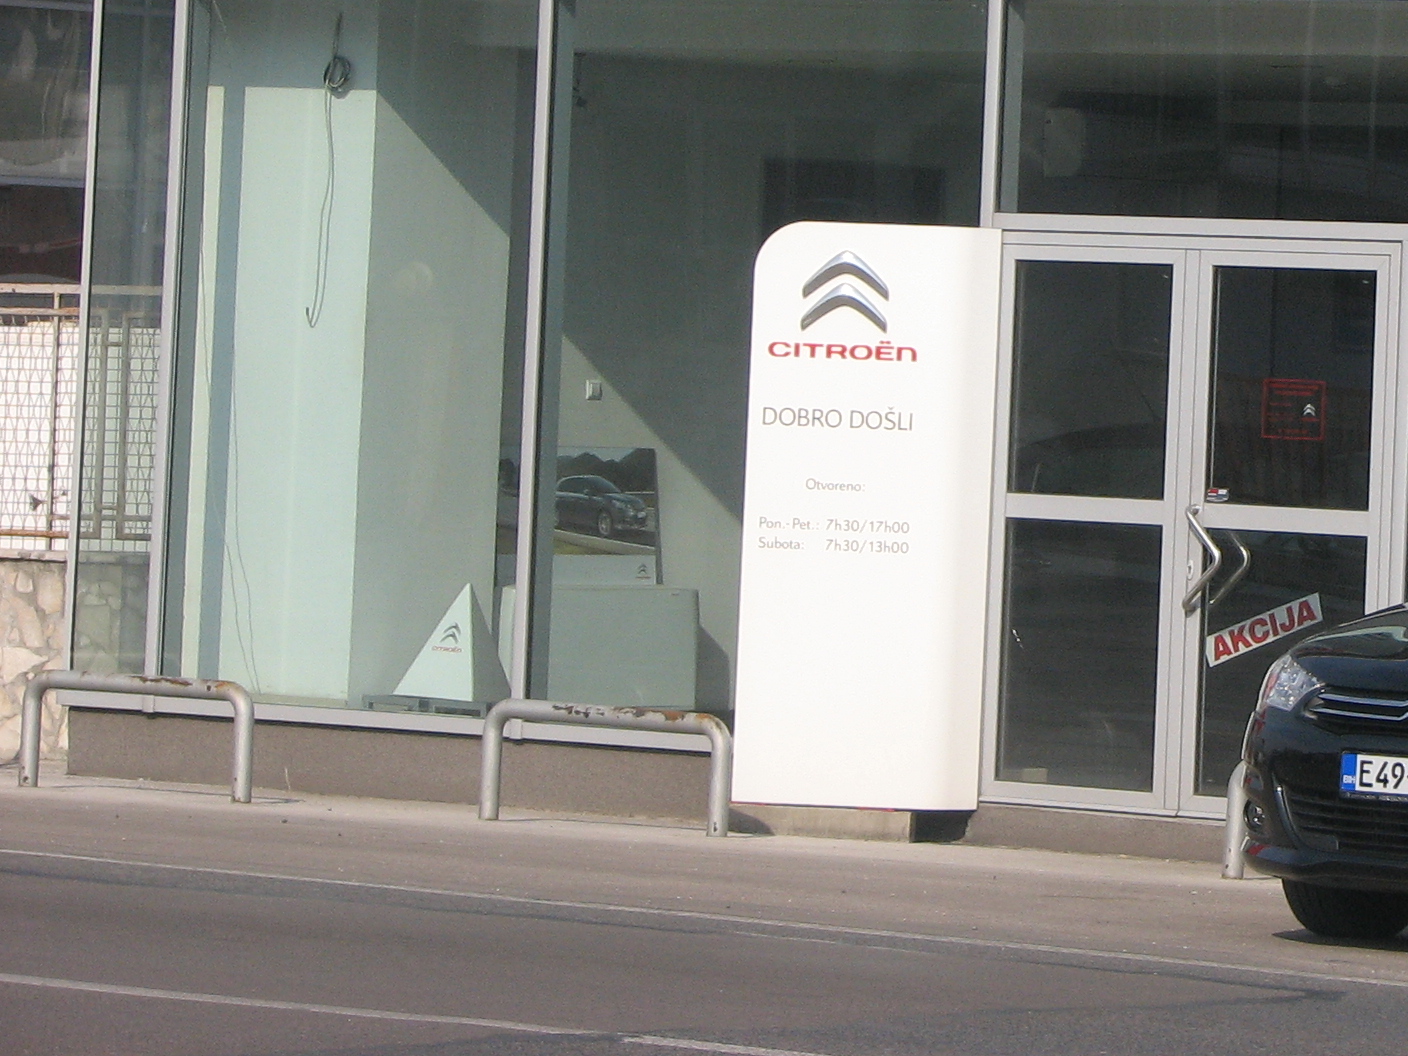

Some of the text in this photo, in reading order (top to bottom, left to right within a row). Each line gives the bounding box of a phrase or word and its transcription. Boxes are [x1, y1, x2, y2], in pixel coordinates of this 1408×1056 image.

[762, 406, 913, 431] DOBRO DOŠLI
[805, 477, 866, 492] Otvoreno:
[825, 518, 910, 534] 7h30/17h00
[757, 536, 910, 554] Subota: 7h30/13h00
[1213, 599, 1317, 662] AKCIJA
